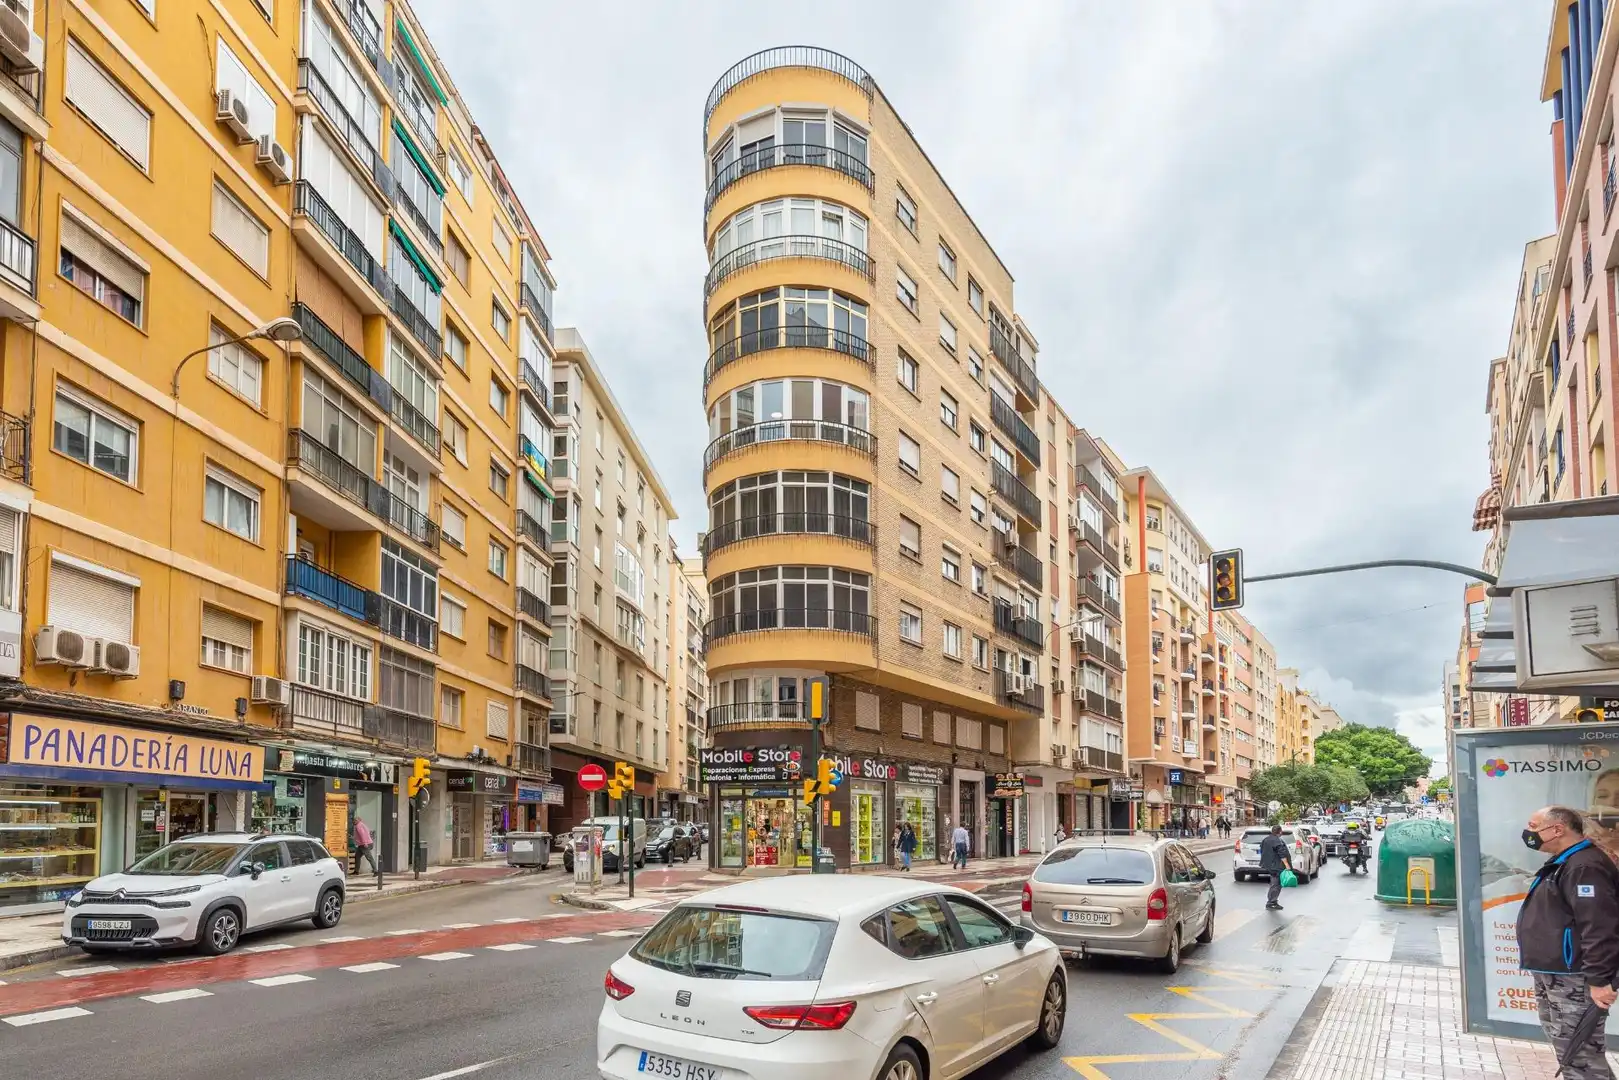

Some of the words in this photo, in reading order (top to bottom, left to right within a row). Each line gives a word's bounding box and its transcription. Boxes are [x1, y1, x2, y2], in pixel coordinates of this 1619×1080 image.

[23, 724, 189, 773] PANADERÍA
[200, 745, 252, 778] LUNA
[702, 750, 754, 764] Mobile
[758, 749, 801, 762] Store
[702, 767, 747, 775] Reparaciones
[748, 766, 776, 774] Express
[864, 759, 897, 780] Store
[1509, 759, 1602, 773] TASSIMO
[1068, 912, 1091, 921] 3960
[1093, 913, 1110, 923] DHK
[1494, 921, 1506, 929] La
[1498, 987, 1535, 999] ¿QUÉ
[1499, 999, 1507, 1008] A
[660, 1012, 706, 1026] LEON
[648, 1055, 682, 1078] 5355
[685, 1064, 716, 1080] HSY
